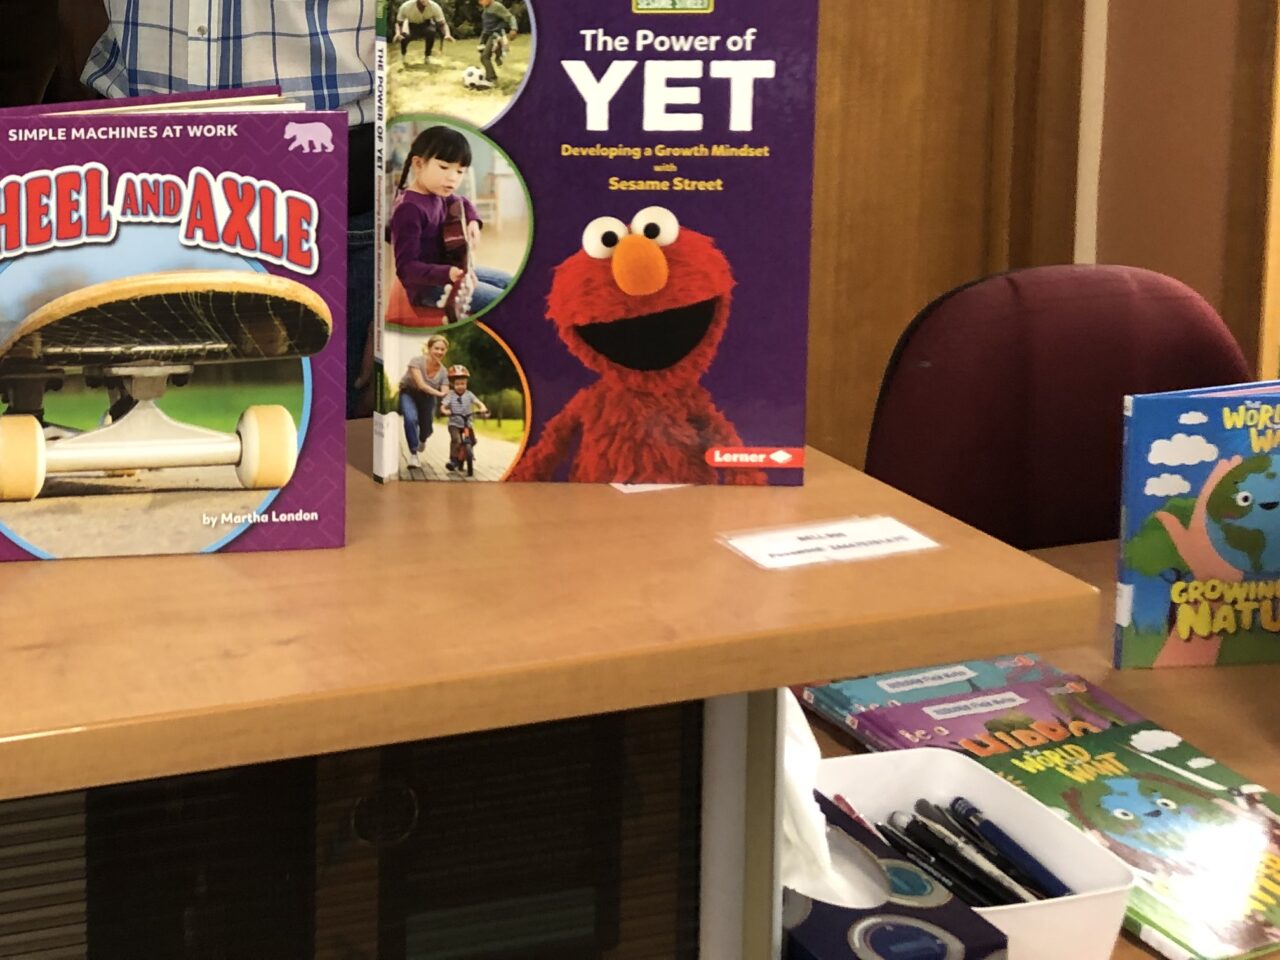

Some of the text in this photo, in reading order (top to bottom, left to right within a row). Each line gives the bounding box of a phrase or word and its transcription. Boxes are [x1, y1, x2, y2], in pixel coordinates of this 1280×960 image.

[581, 29, 757, 52] The Power of
[560, 60, 776, 133] YET
[376, 48, 384, 171] THE POWER OF YET
[8, 124, 238, 142] SIMPLE MACHINES AT WORK
[561, 144, 770, 160] Developing a Growth Mindset
[654, 163, 677, 172] with
[608, 177, 724, 191] Sesame Street
[117, 174, 184, 222] AND
[181, 167, 319, 275] AXLE
[714, 451, 766, 464] Lerner
[202, 510, 318, 527] by Martha London
[1171, 580, 1280, 604] GROWIN
[1010, 743, 1092, 774] WORLD
[1055, 751, 1130, 784] WANT
